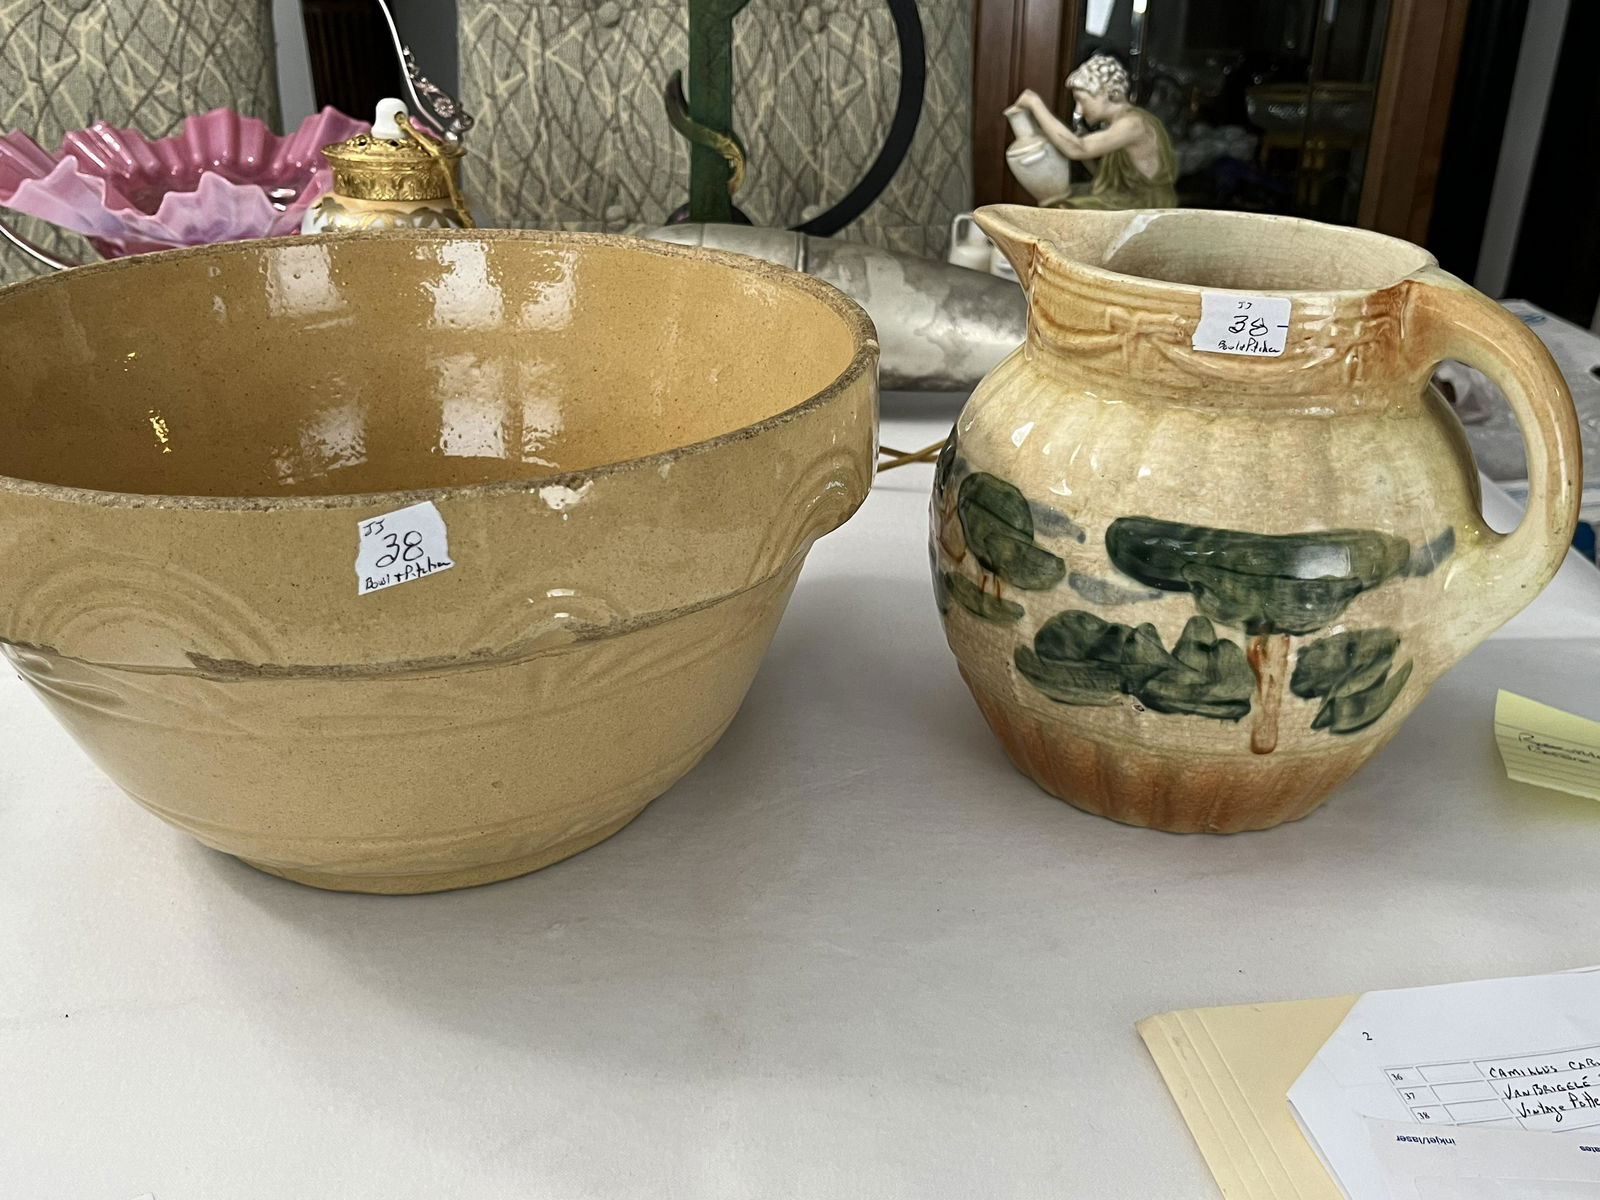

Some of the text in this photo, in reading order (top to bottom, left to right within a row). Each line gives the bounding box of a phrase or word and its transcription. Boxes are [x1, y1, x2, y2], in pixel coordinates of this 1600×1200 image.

[1228, 315, 1269, 337] 38
[375, 530, 424, 568] 38
[1362, 1031, 1373, 1041] 2
[1391, 1073, 1404, 1081] 36
[1405, 1092, 1416, 1100] 37
[1417, 1111, 1431, 1120] 38
[1396, 1134, 1457, 1146] inkjet/laser
